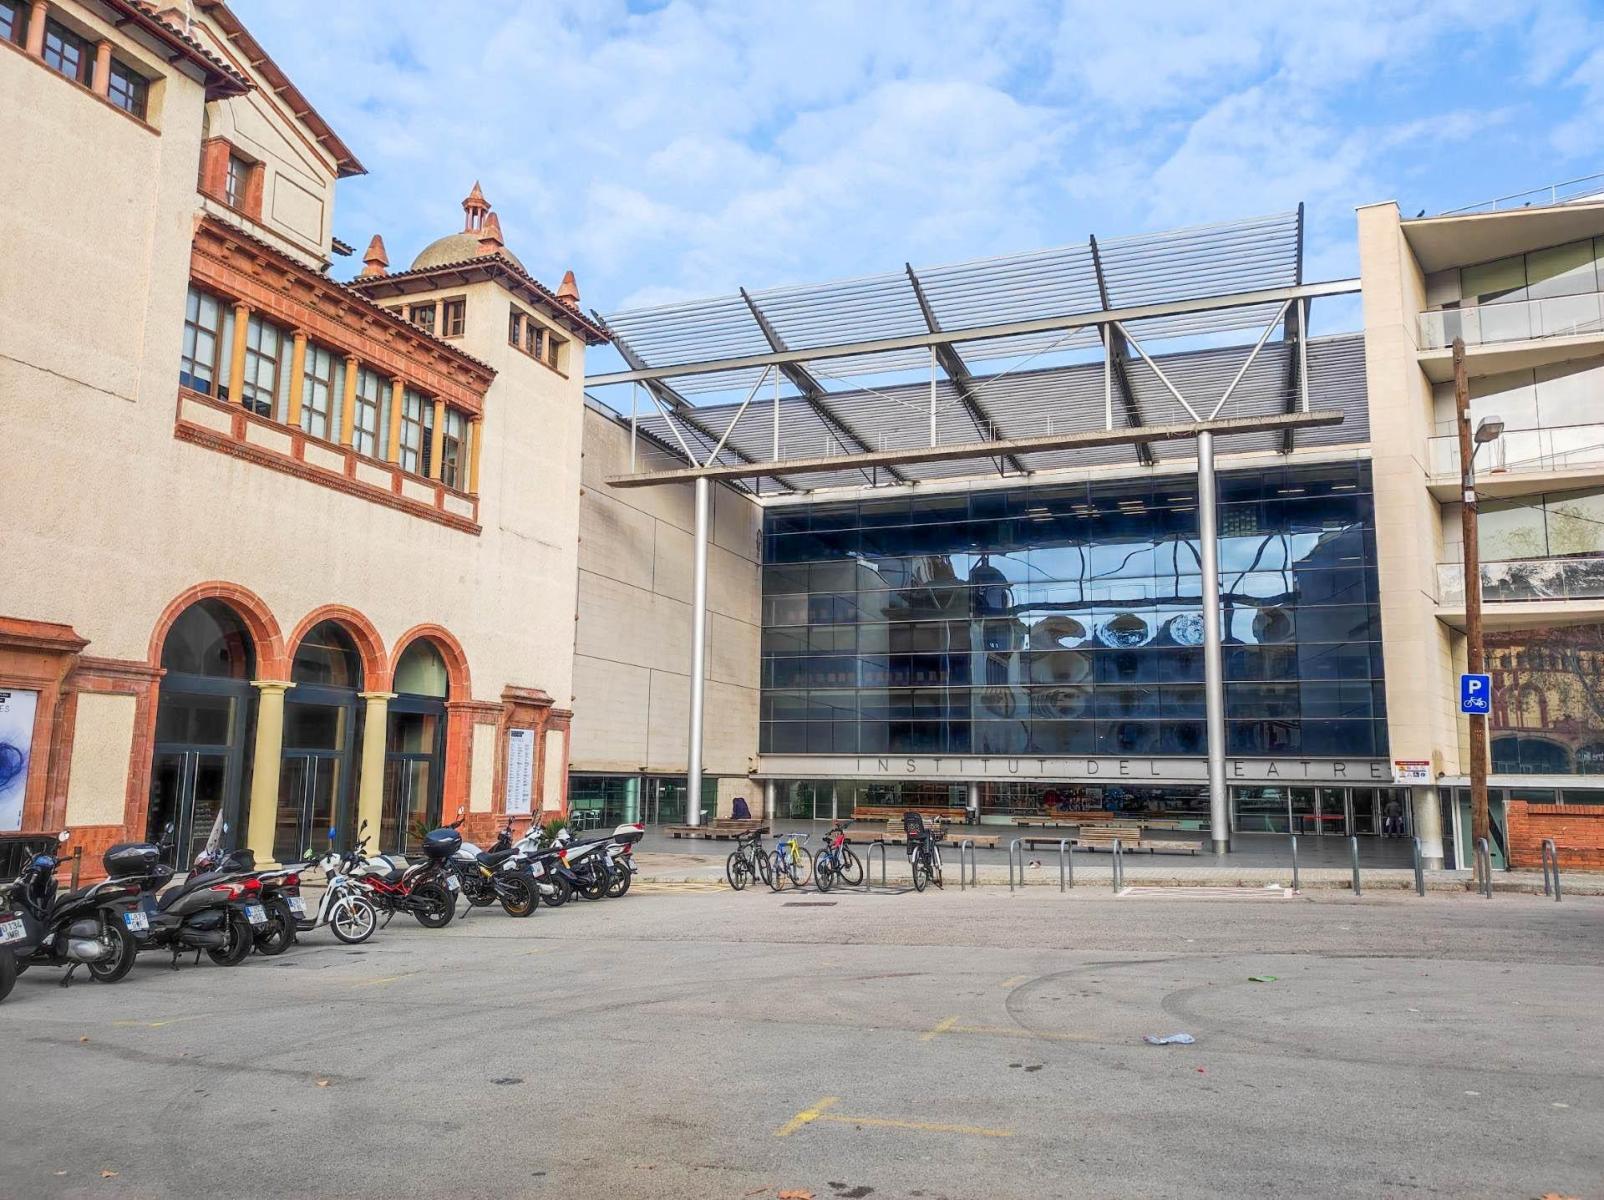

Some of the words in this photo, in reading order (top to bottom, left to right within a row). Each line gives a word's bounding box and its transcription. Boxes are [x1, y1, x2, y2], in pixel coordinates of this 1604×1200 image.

[1469, 680, 1481, 694] P
[857, 759, 1047, 774] INSTITUT
[1087, 760, 1160, 775] DEL
